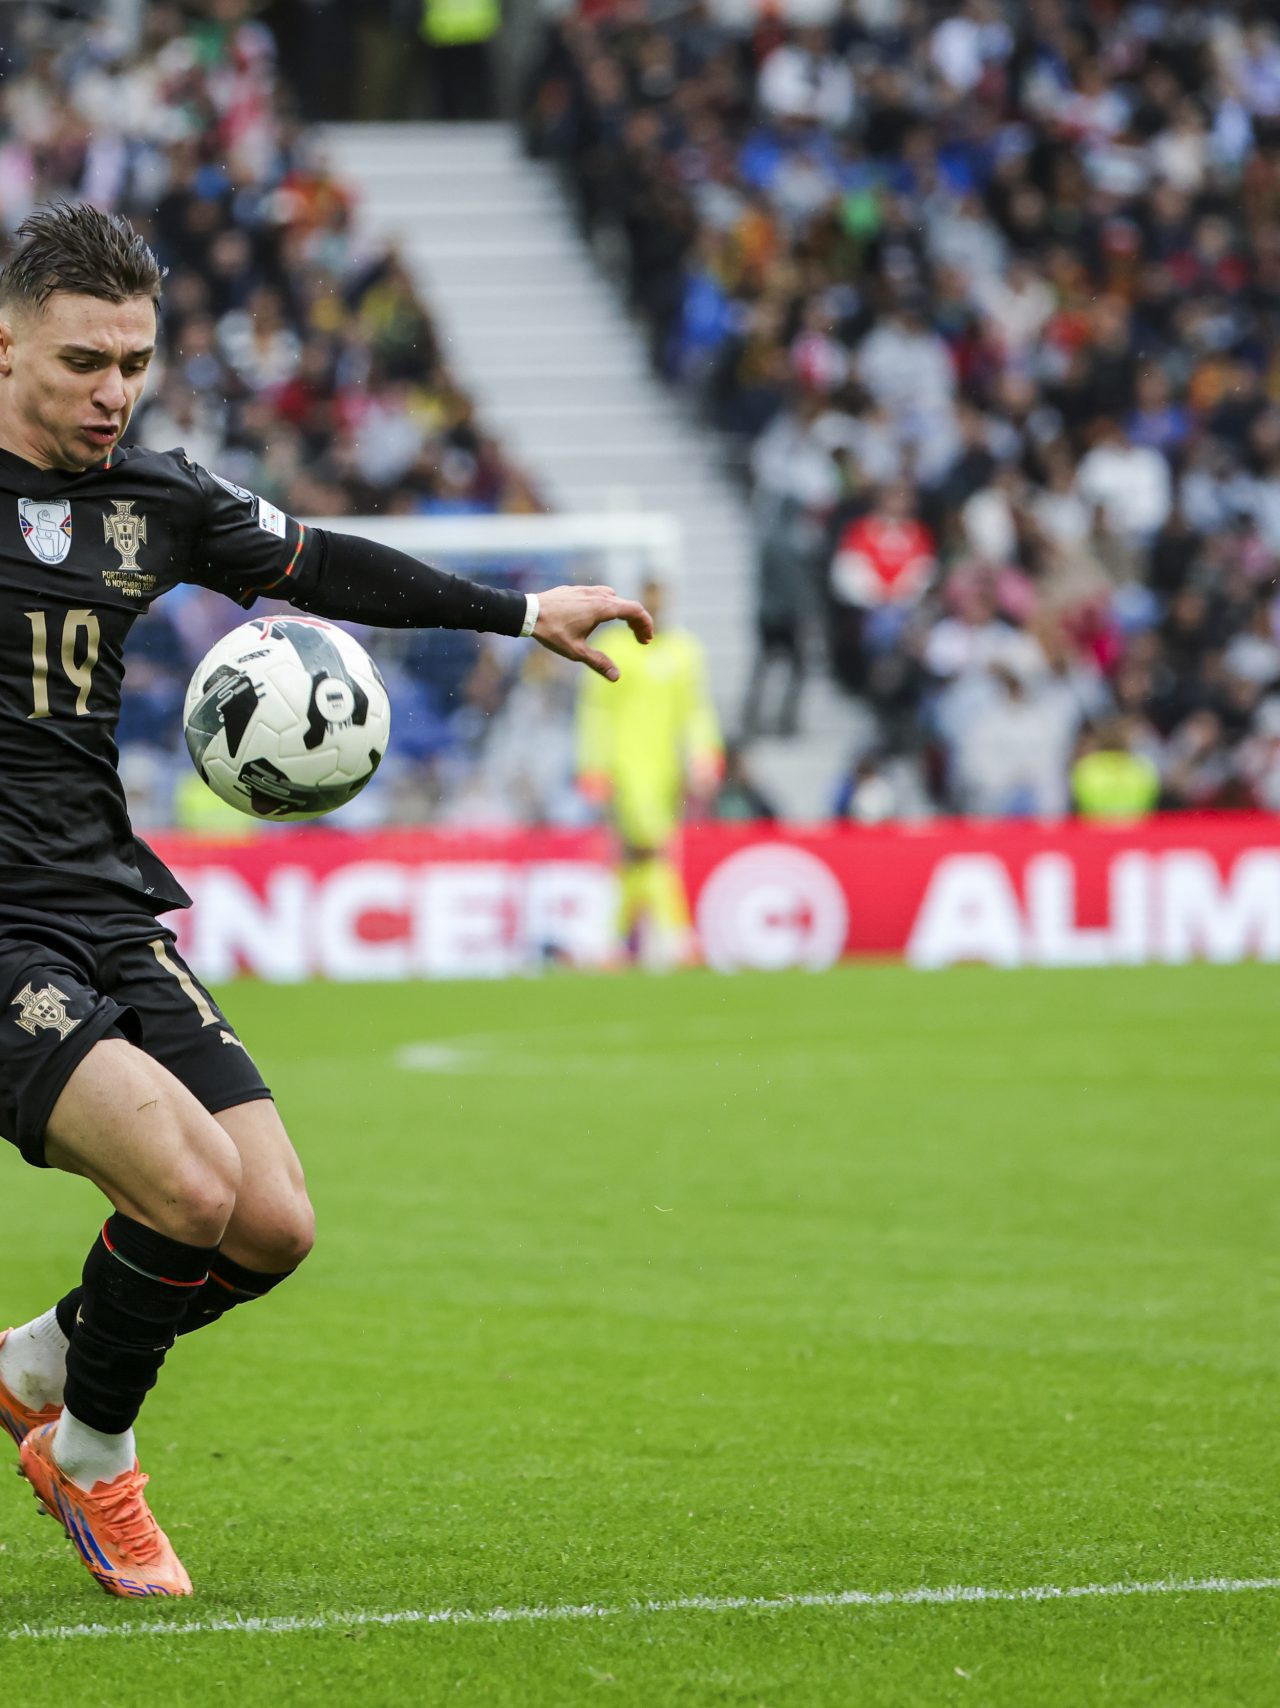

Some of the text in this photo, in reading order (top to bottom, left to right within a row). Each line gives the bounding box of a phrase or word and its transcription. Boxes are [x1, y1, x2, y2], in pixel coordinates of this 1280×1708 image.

[122, 588, 142, 598] PORTO
[24, 609, 101, 719] 19
[160, 860, 619, 982] NCER
